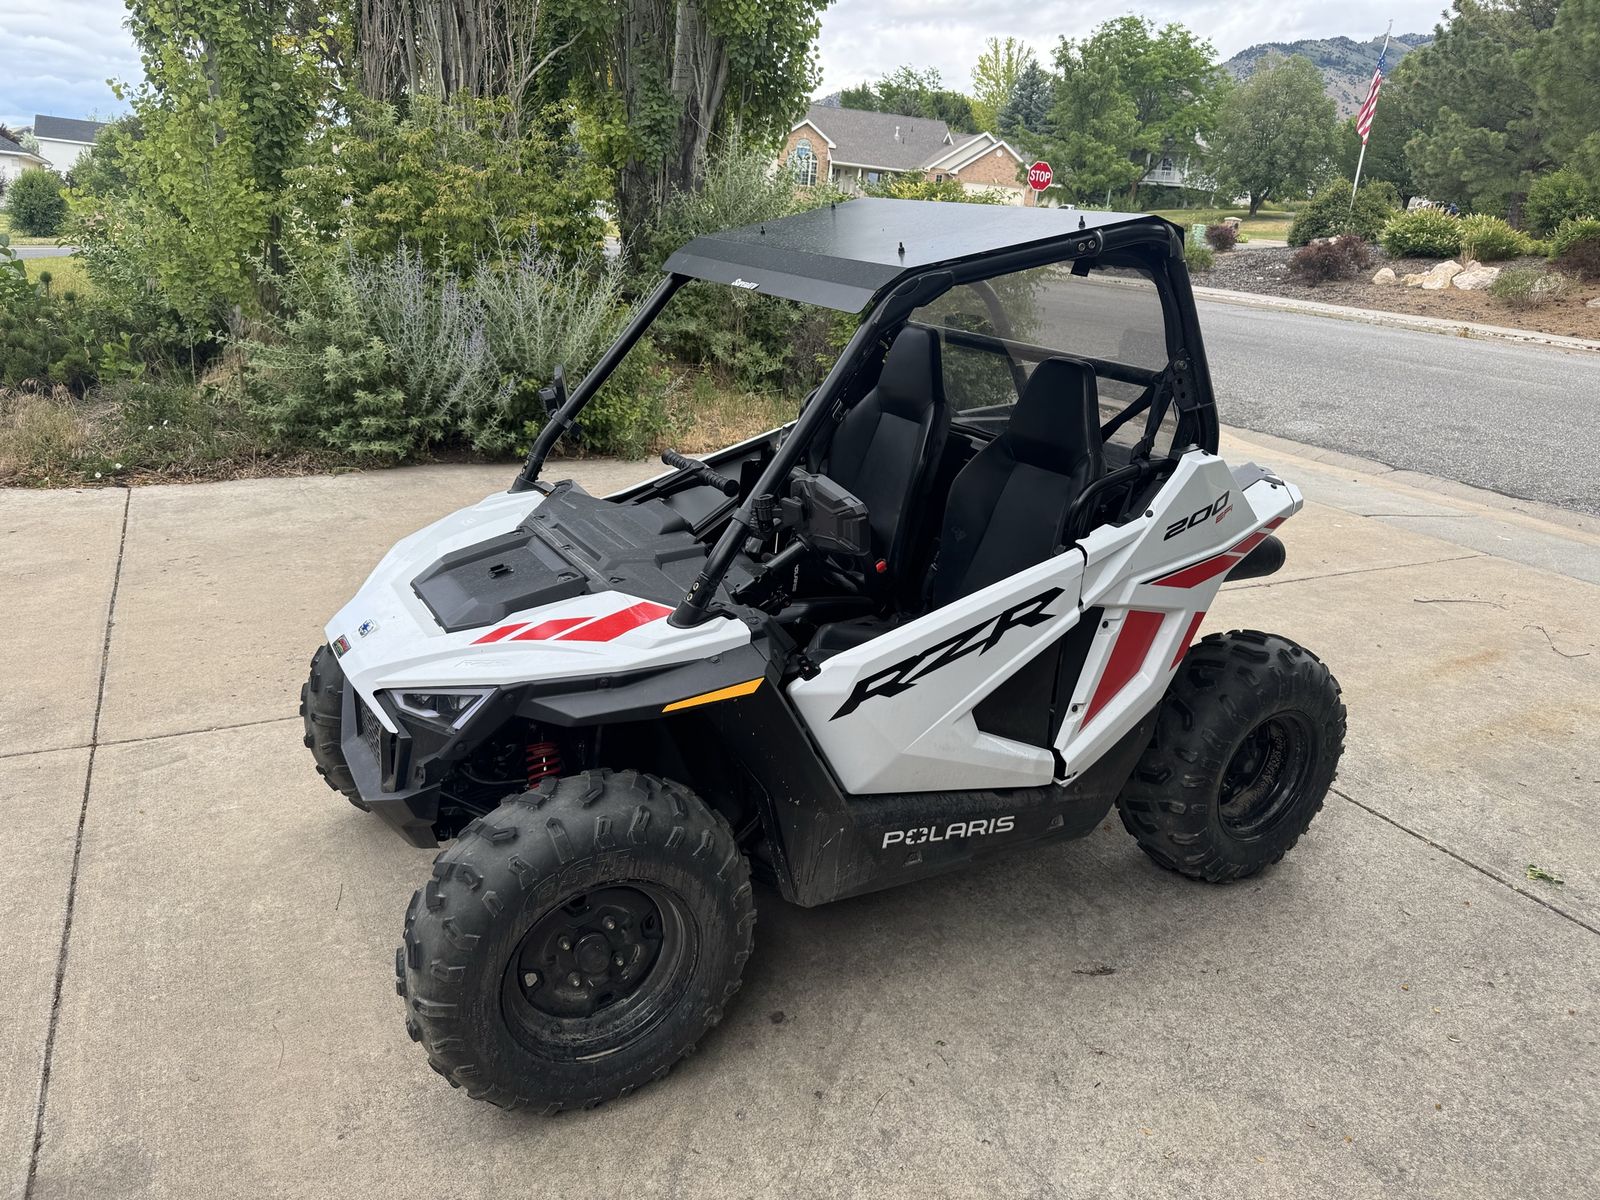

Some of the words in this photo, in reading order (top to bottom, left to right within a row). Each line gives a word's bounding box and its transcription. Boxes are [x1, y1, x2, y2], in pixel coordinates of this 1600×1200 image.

[1029, 170, 1051, 182] STOP
[1163, 490, 1230, 541] 200
[829, 587, 1065, 722] RZR
[882, 815, 1015, 849] POLARIS
